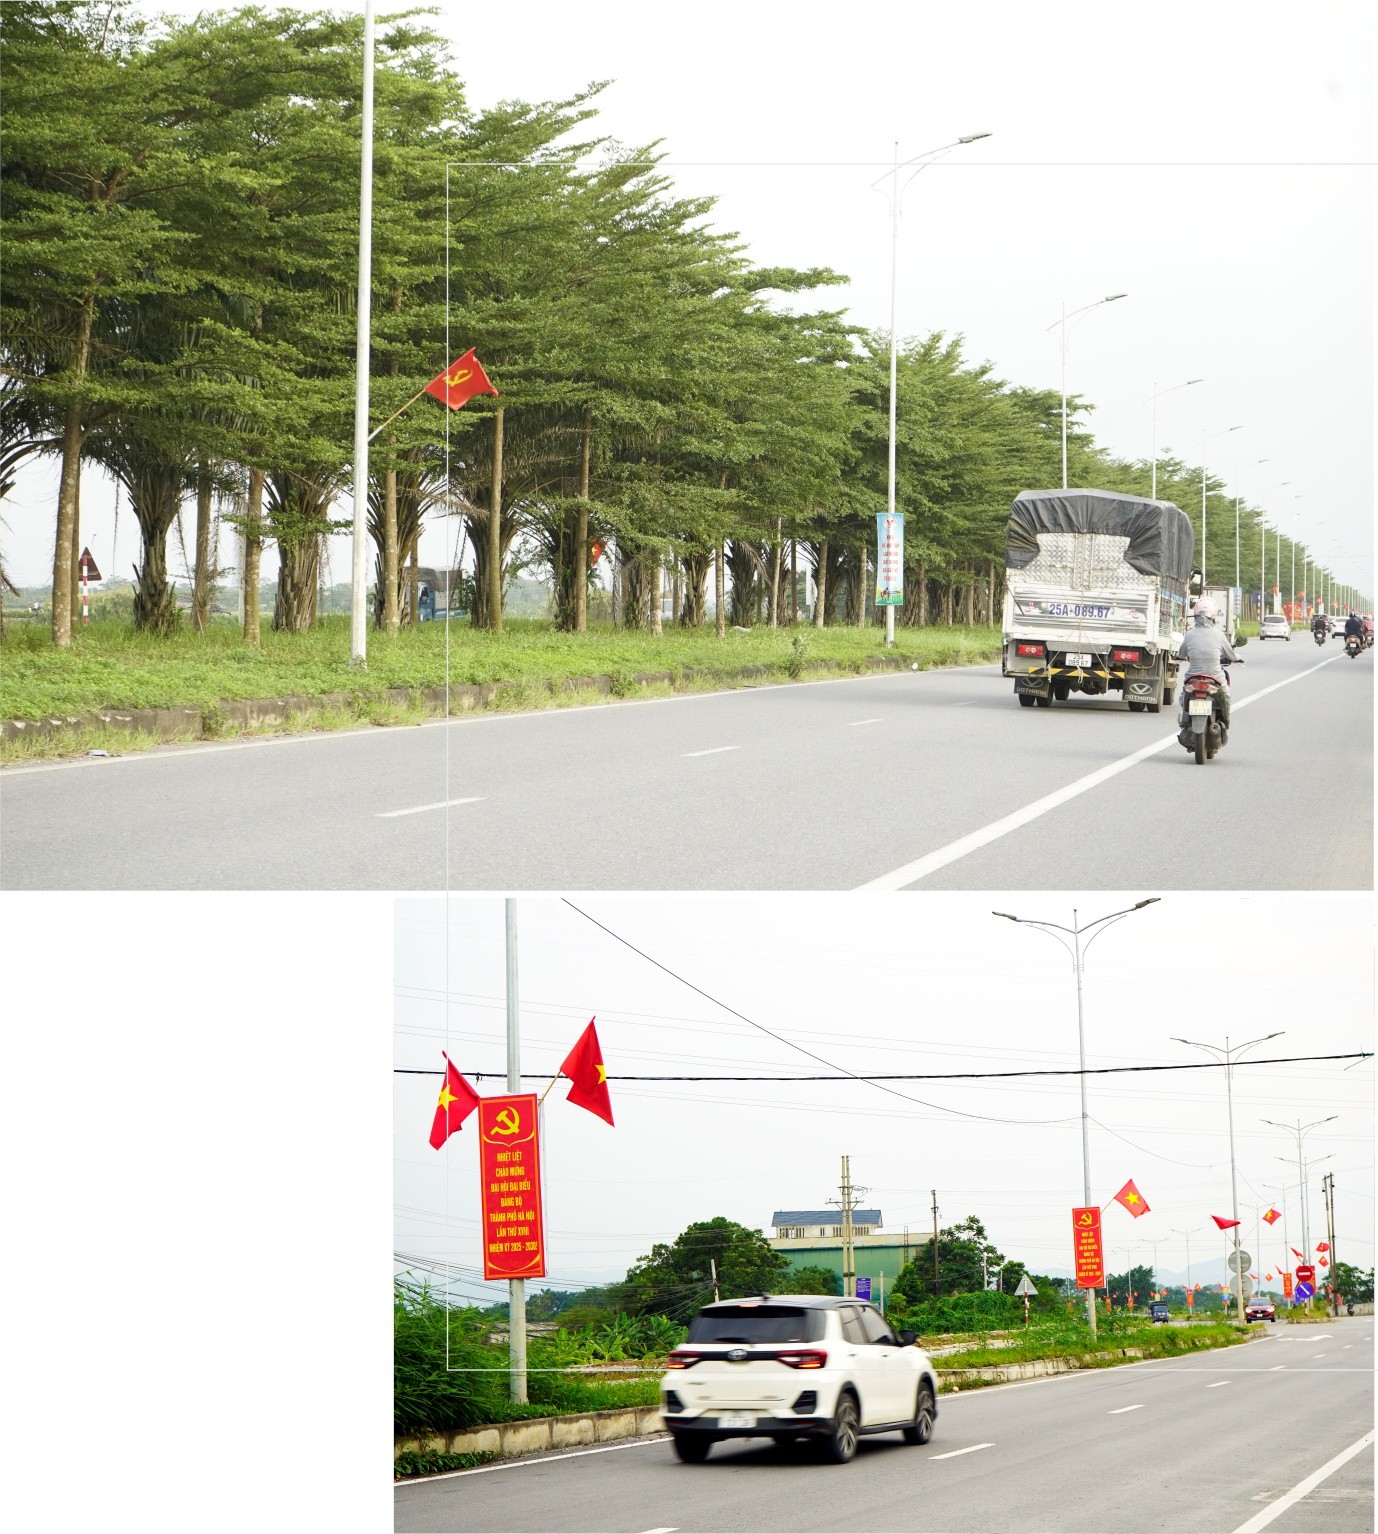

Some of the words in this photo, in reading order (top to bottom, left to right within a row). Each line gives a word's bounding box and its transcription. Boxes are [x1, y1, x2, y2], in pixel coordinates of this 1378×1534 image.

[1049, 604, 1110, 619] 25A-089.67
[497, 1151, 511, 1163] NHIỆT
[512, 1150, 522, 1162] LIỆT
[496, 1165, 509, 1177] CHÀO
[519, 1178, 531, 1190] BIỂU
[501, 1195, 514, 1207] ĐẢNG
[490, 1211, 506, 1222] THÀNH
[518, 1210, 525, 1221] HÀ
